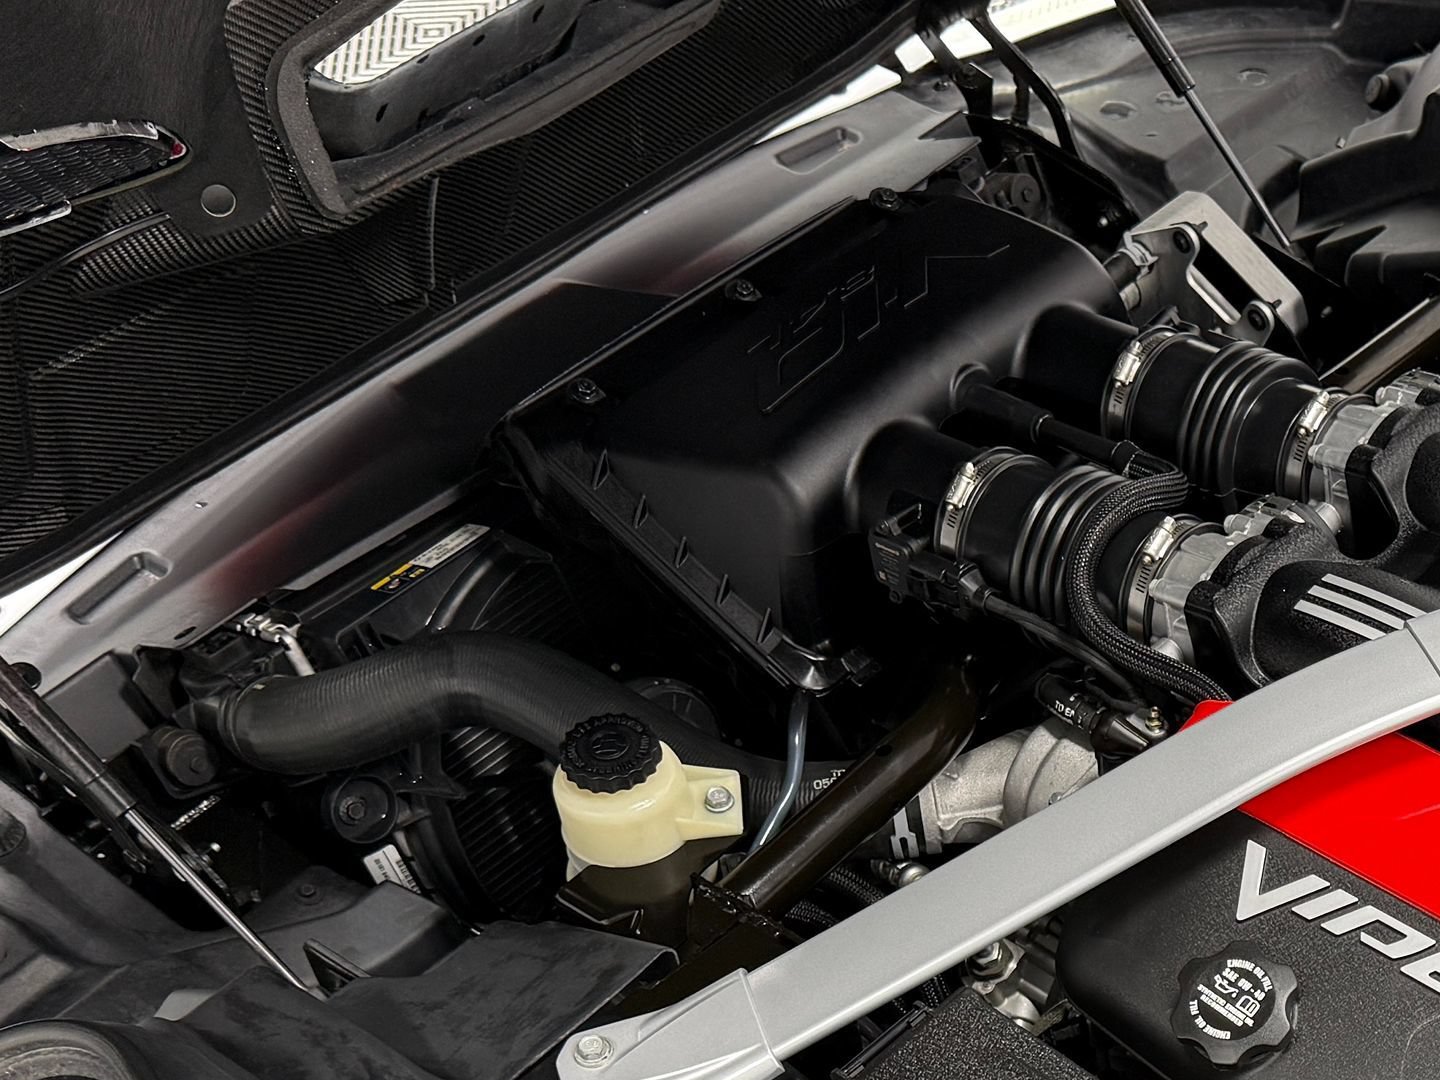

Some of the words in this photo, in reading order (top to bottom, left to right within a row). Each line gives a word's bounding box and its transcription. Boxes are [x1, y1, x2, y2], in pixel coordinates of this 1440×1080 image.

[813, 777, 838, 790] 05
[1222, 968, 1240, 982] SAE
[1227, 959, 1255, 971] ENGINE
[1253, 967, 1265, 980] OIL
[1261, 977, 1274, 992] FILL
[1189, 1000, 1200, 1015] FILL
[1200, 994, 1243, 1027] RECOMMENDED
[1194, 1015, 1206, 1029] OIL
[1203, 1025, 1231, 1039] ENGINE
